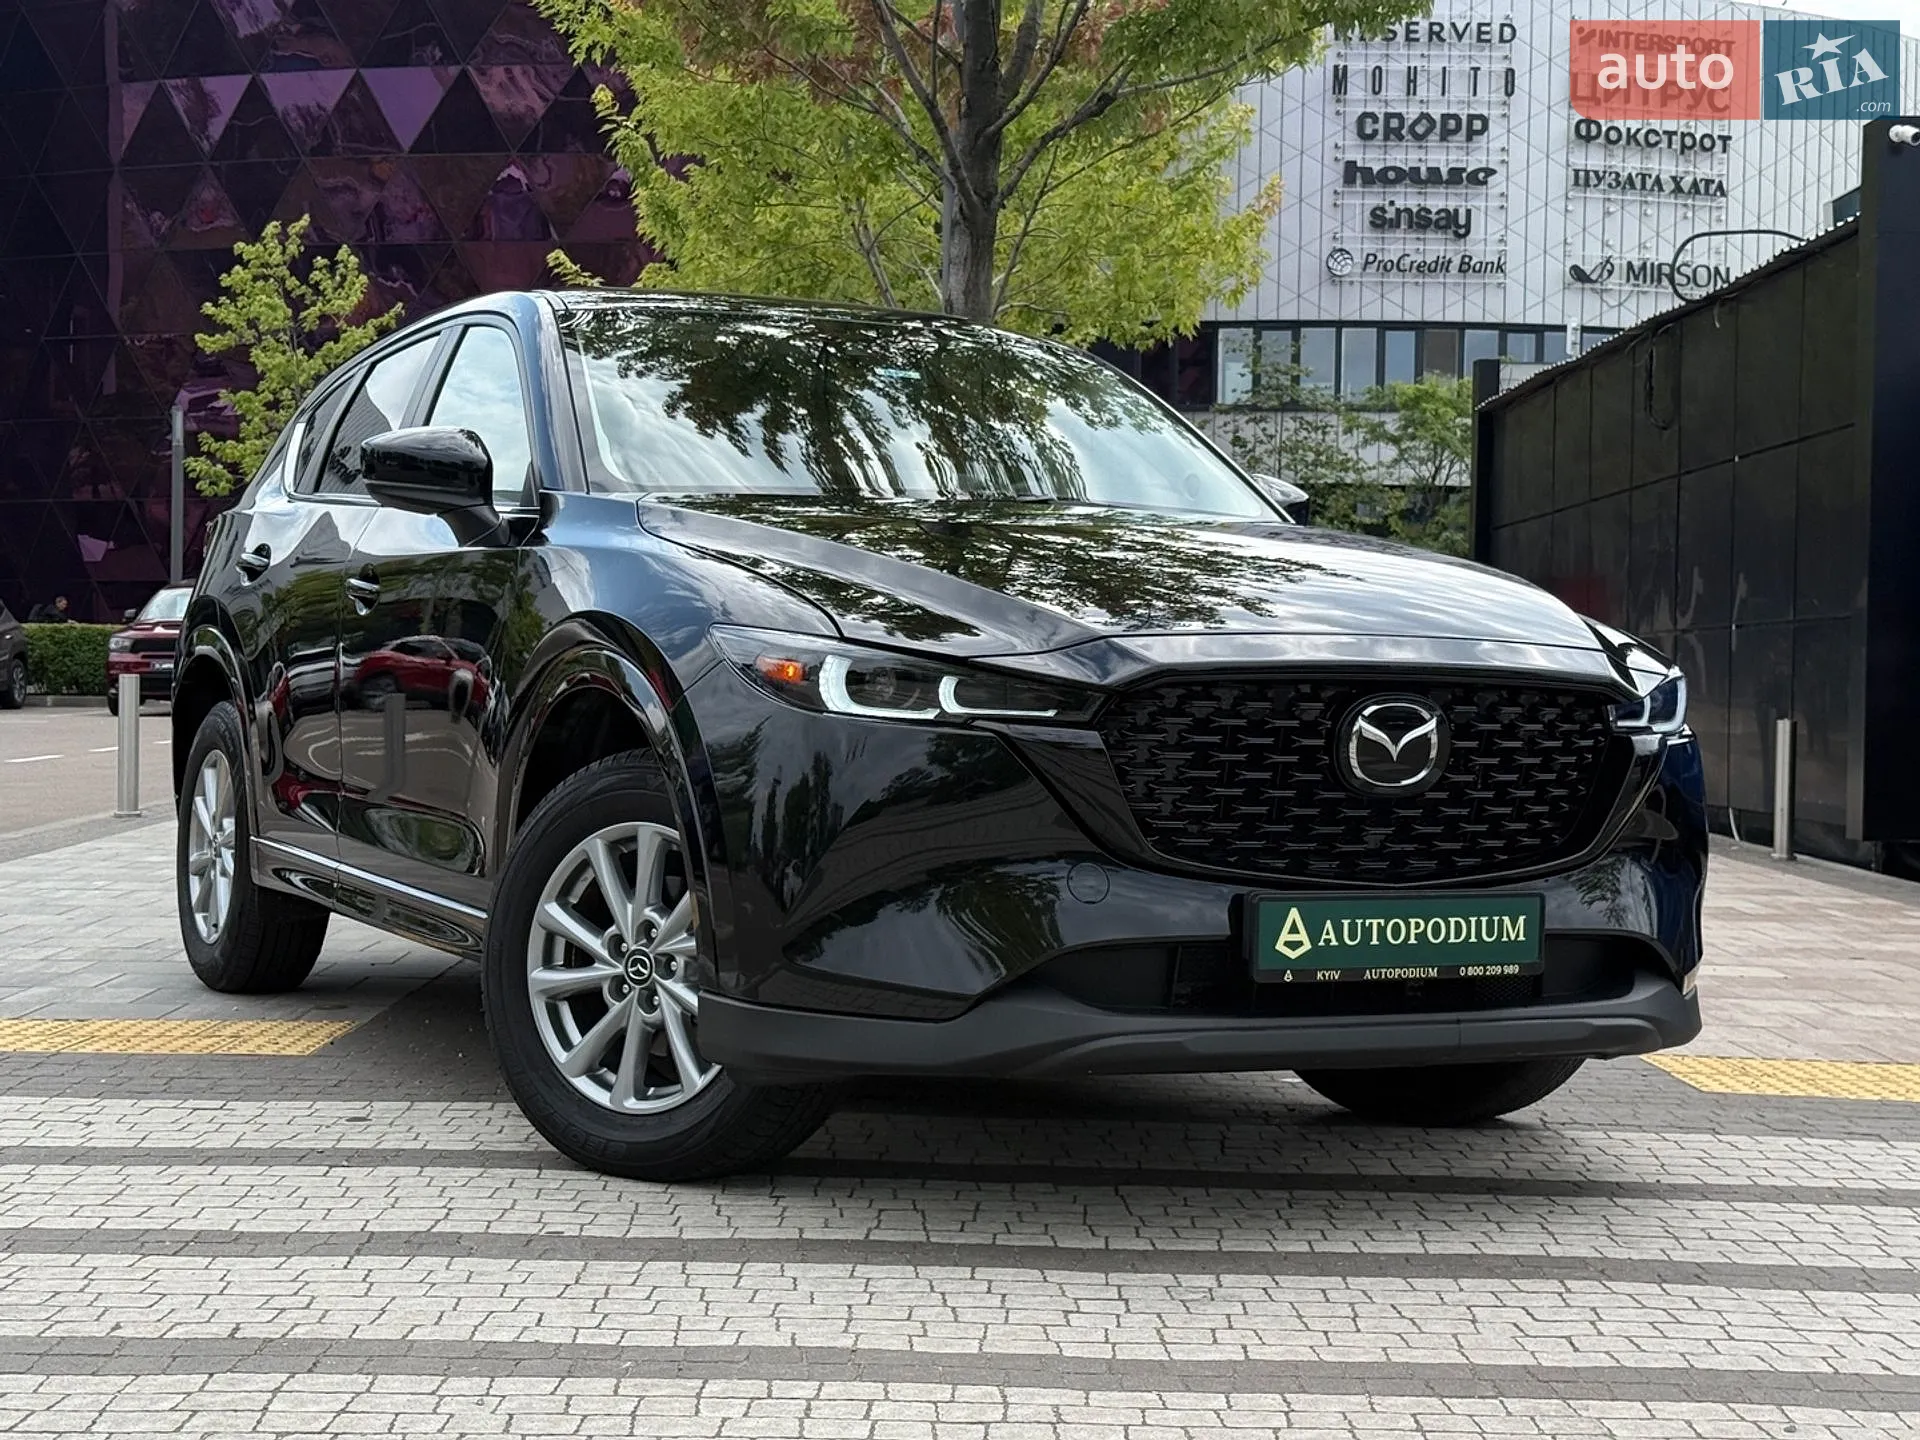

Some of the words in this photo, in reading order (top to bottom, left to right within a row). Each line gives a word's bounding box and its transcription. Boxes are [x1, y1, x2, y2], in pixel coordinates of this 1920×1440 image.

[1332, 64, 1516, 97] MOHITO
[1356, 111, 1489, 142] CROPP
[1574, 118, 1733, 155] Фокстрот
[1343, 160, 1498, 186] house
[1572, 168, 1665, 193] ПУЗАТА
[1669, 175, 1727, 197] ХАТА
[1369, 200, 1472, 239] sinsay
[1362, 253, 1456, 275] ProCredit
[1457, 254, 1506, 275] Bank
[1625, 260, 1731, 288] MIRSON
[1318, 915, 1527, 947] AUTOPODIUM
[1316, 970, 1341, 981] KYIV
[1363, 967, 1439, 979] AUTOPODIUM
